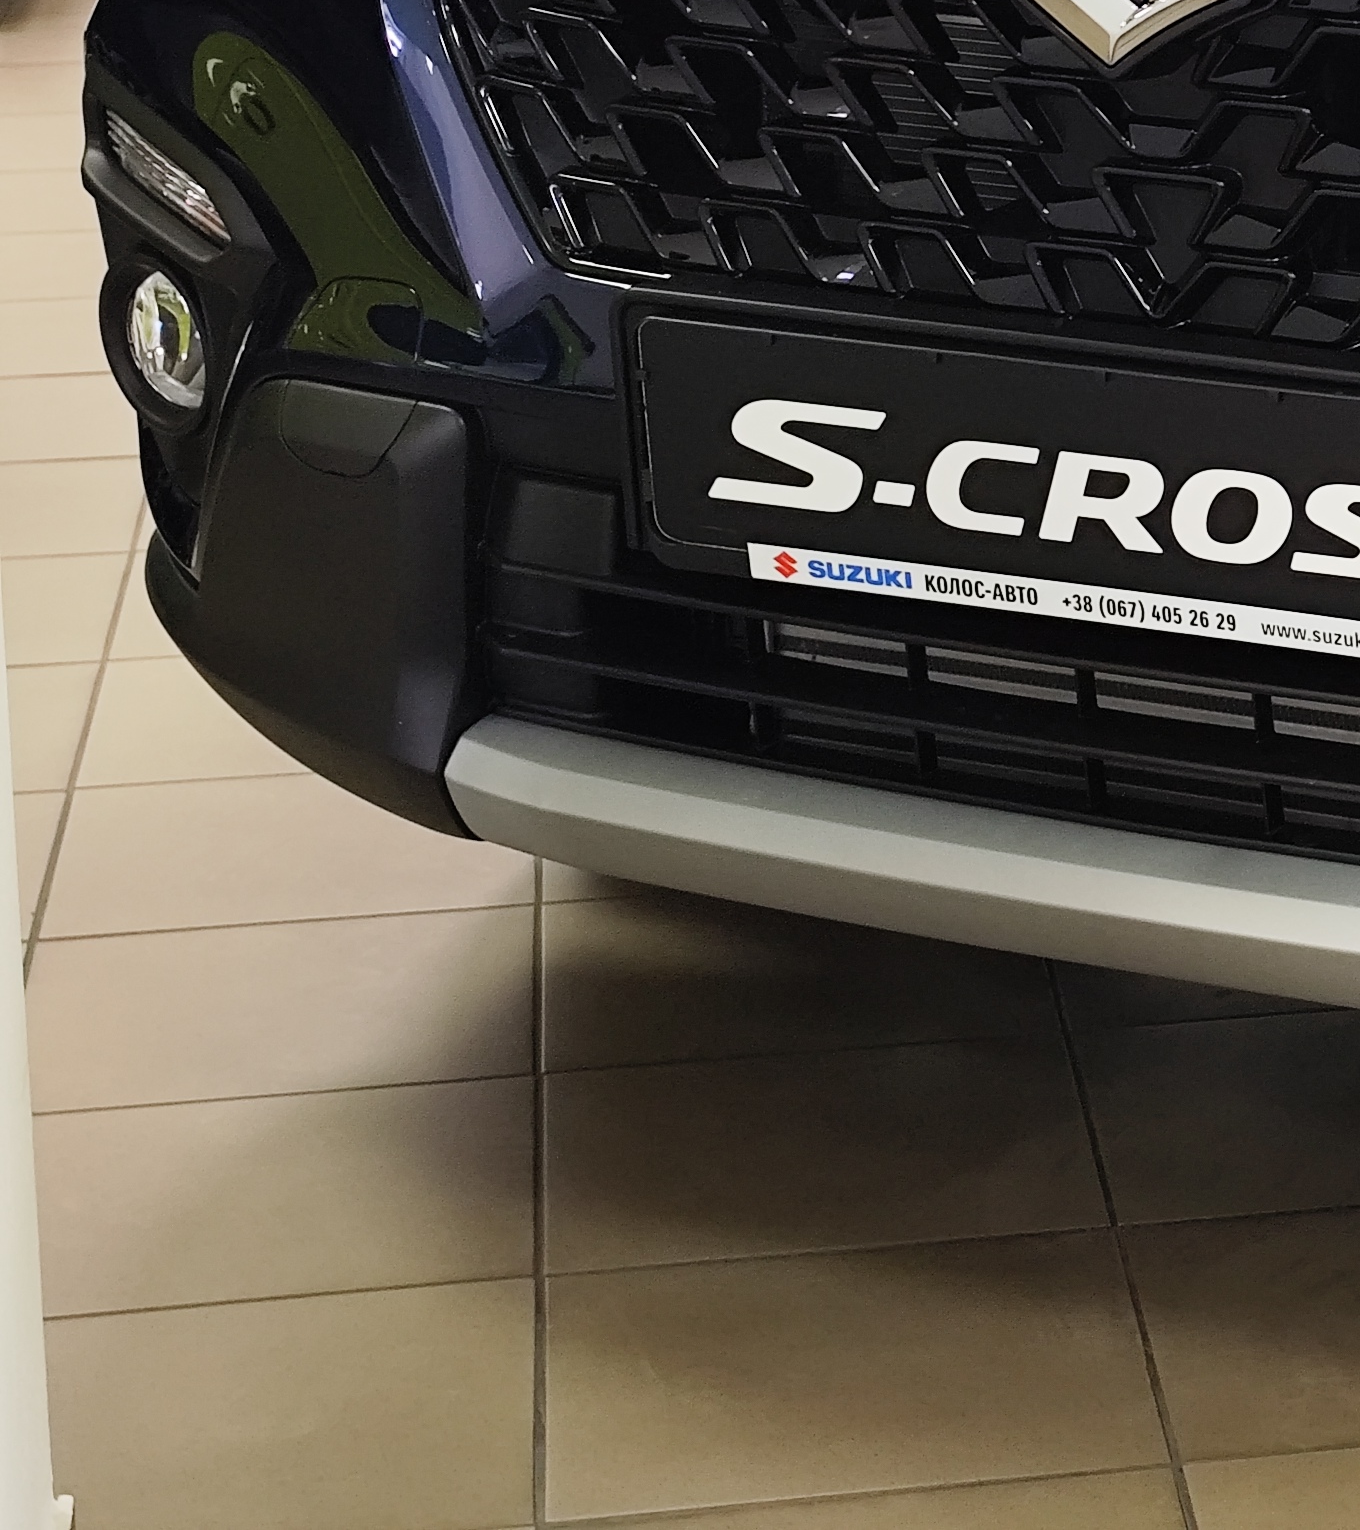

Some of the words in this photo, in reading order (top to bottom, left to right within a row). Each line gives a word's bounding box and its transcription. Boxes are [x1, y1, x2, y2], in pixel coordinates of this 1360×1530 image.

[807, 559, 913, 589] SUZUKI
[924, 573, 1039, 606] КОЛОС-АВТО
[1062, 593, 1094, 614] +38
[1099, 595, 1146, 624] (067)
[1151, 604, 1183, 625] 405
[1188, 609, 1210, 629] 26
[1215, 612, 1237, 633] 29
